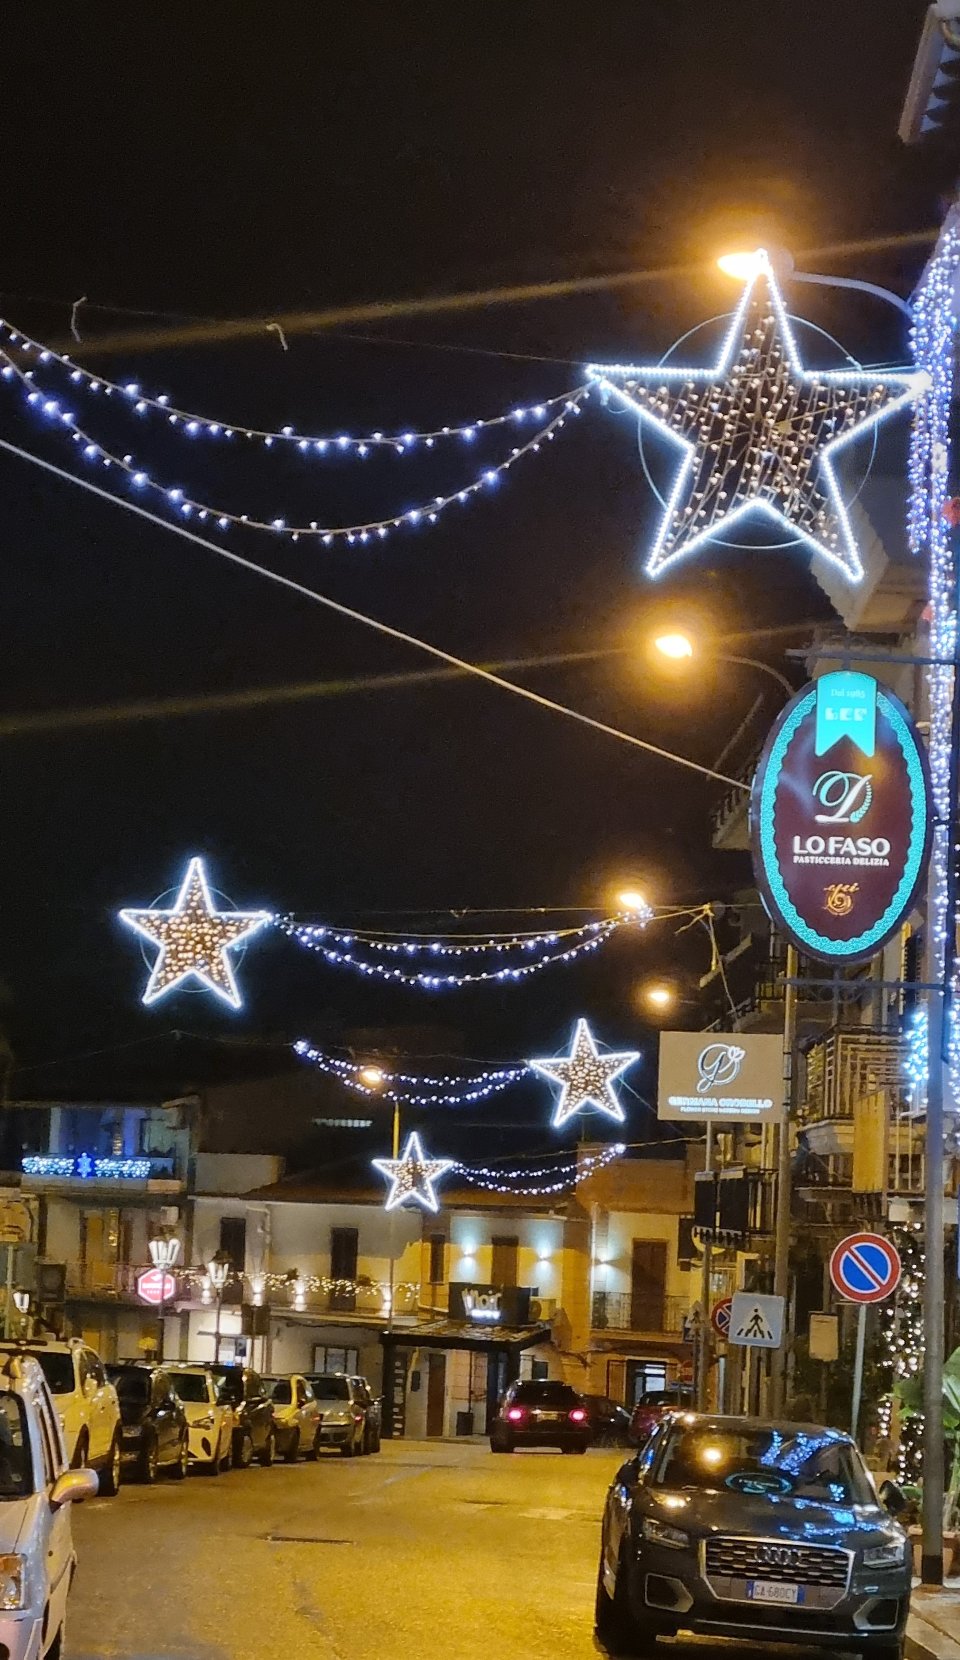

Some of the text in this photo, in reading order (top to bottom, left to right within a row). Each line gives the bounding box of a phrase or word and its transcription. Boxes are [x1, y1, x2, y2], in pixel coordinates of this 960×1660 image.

[793, 835, 891, 857] LO FASO
[793, 855, 890, 867] PASTICCERIA DELIZIA
